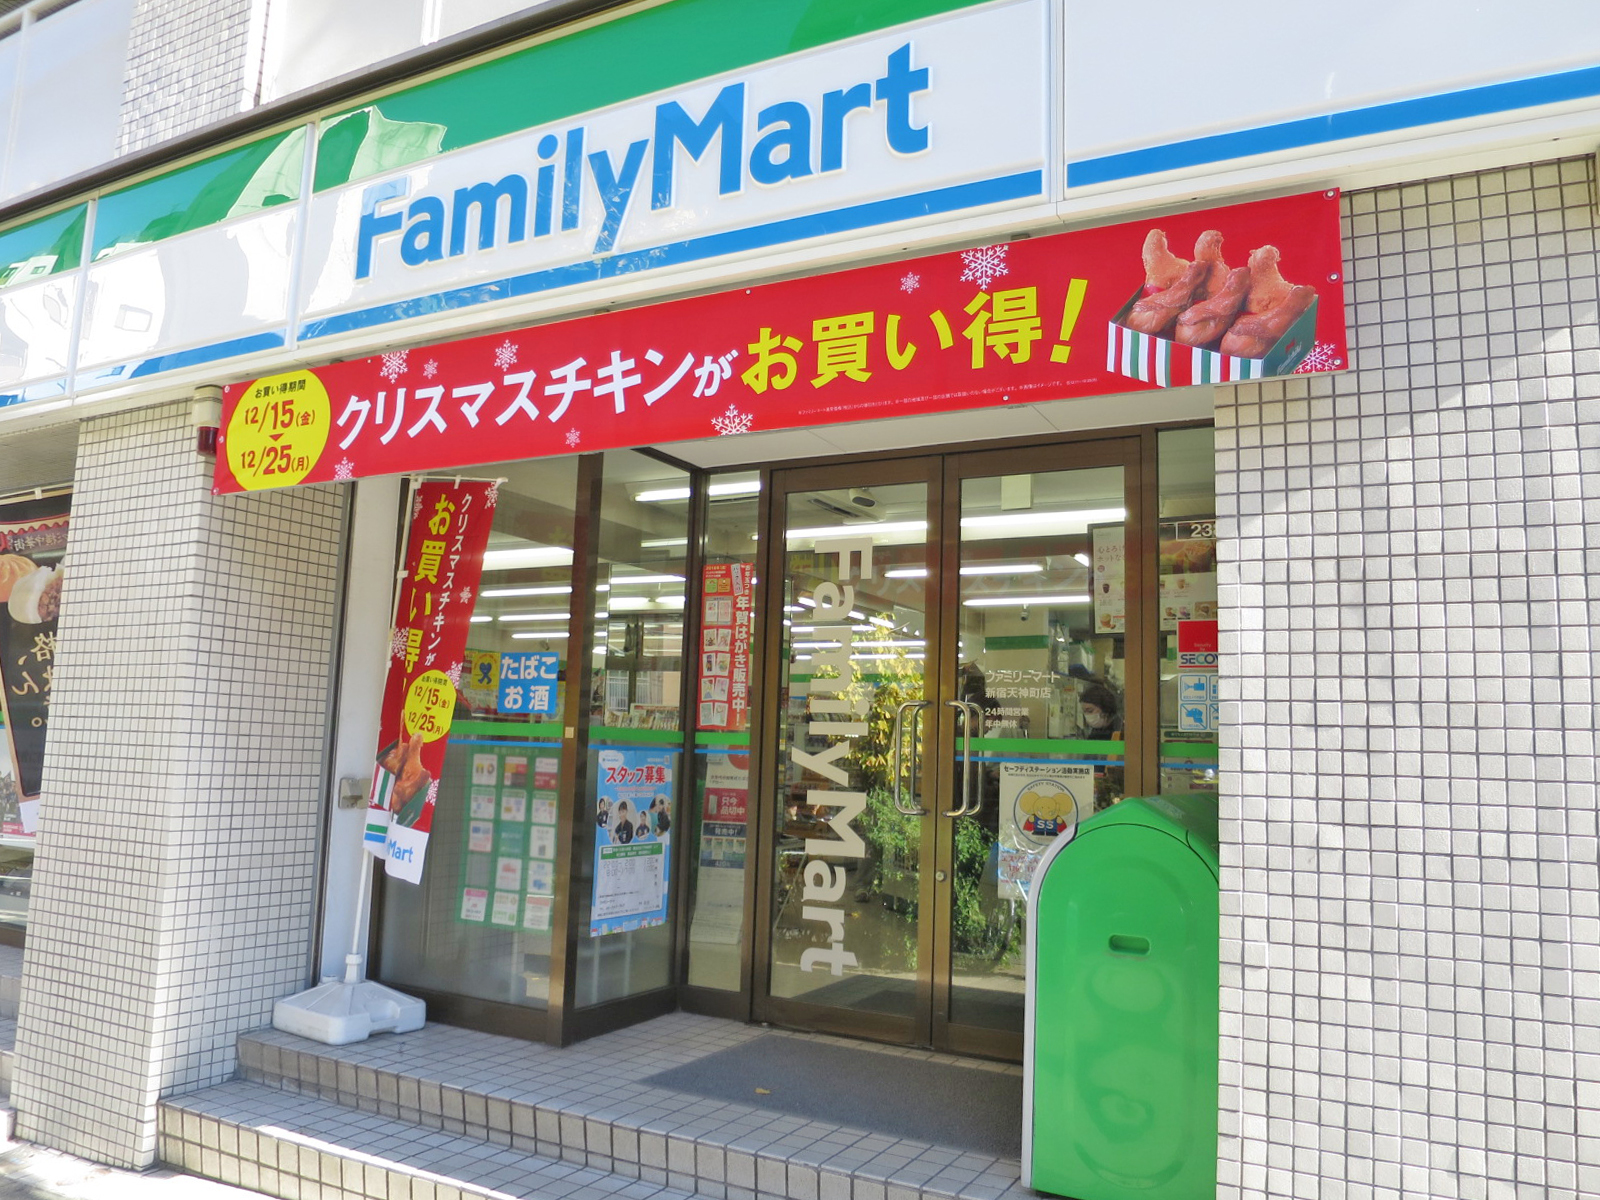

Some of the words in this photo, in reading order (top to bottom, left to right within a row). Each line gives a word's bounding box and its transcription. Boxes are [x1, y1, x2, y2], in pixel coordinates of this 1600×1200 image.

[355, 41, 930, 281] FamilyMart
[255, 379, 306, 399] お買い得期間
[1190, 522, 1216, 538] 23
[425, 493, 473, 667] クリスマスチキンが
[501, 655, 557, 680] たばこ
[985, 670, 1061, 683] ファミリーマート
[504, 685, 550, 711] お酒
[985, 687, 1051, 698] 新宿天神町店
[985, 707, 1029, 716] 24時間営業
[791, 537, 873, 976] FamilyMart
[605, 765, 666, 784] スタッフ募集
[1037, 820, 1054, 830] SS
